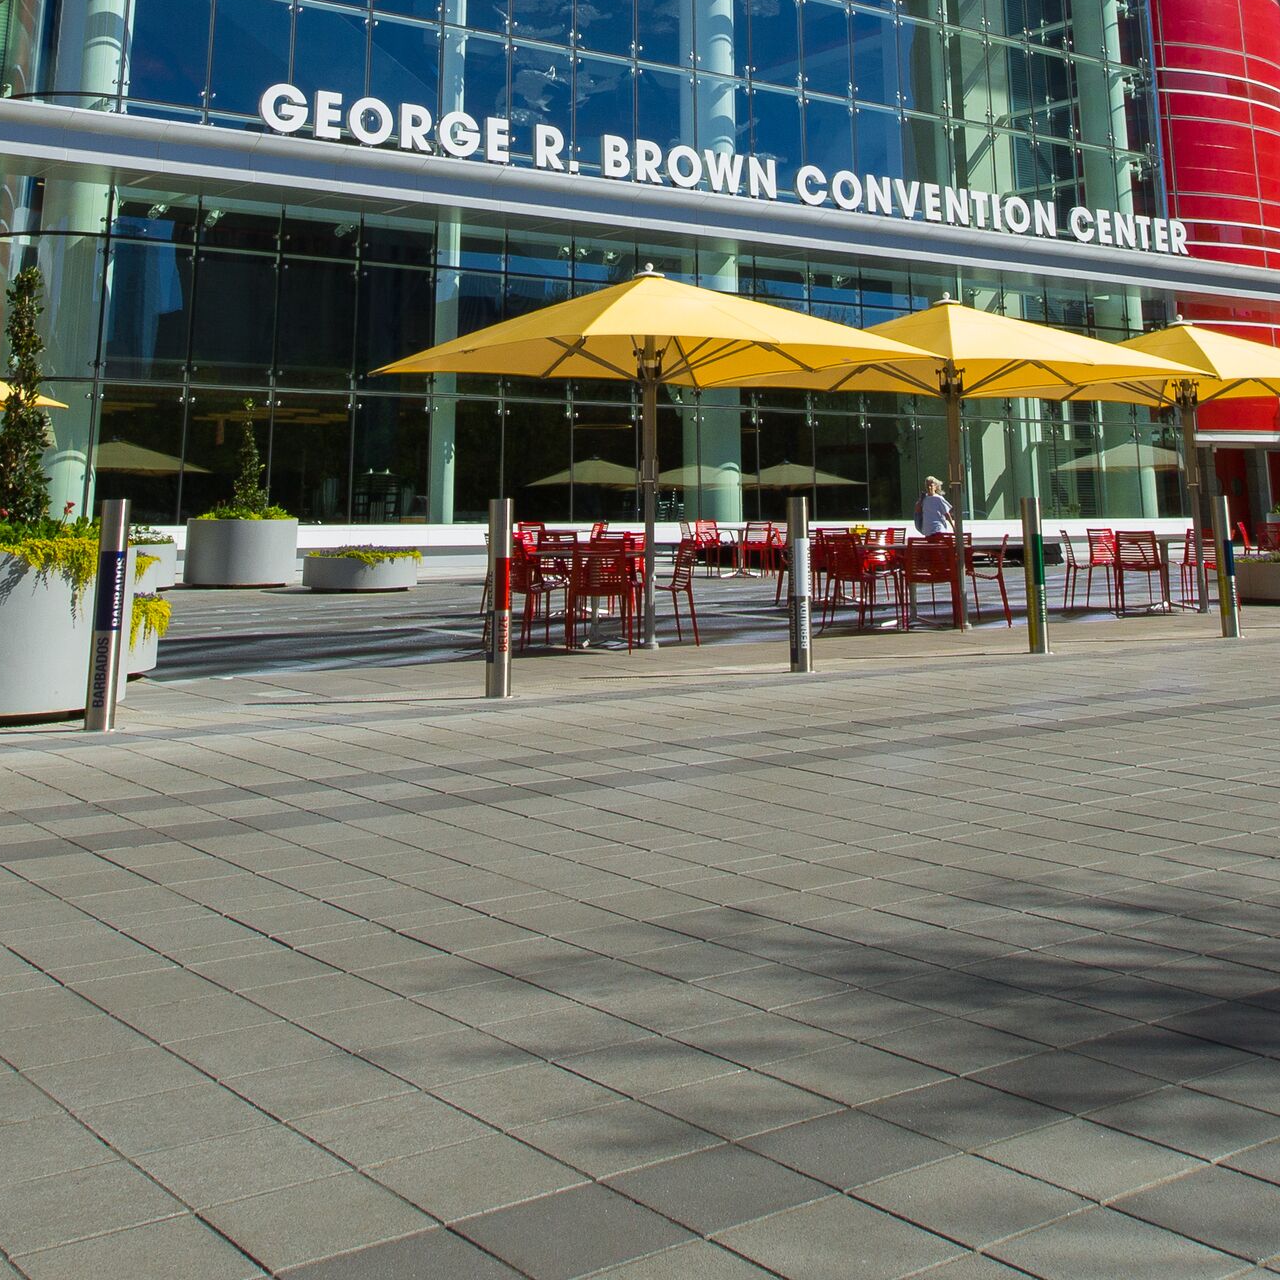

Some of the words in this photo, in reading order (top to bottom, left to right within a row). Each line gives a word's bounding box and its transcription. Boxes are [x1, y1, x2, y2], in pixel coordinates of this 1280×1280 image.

[259, 82, 510, 163] GEORGE
[533, 122, 580, 175] R.
[602, 133, 778, 199] BROWN
[795, 163, 1058, 238] CONVENTION
[1070, 205, 1189, 257] CENTER
[111, 557, 126, 627] BARBADOS
[800, 601, 809, 649] BERMUDA
[498, 616, 509, 653] BELIZE
[92, 636, 110, 709] BARBADOS
